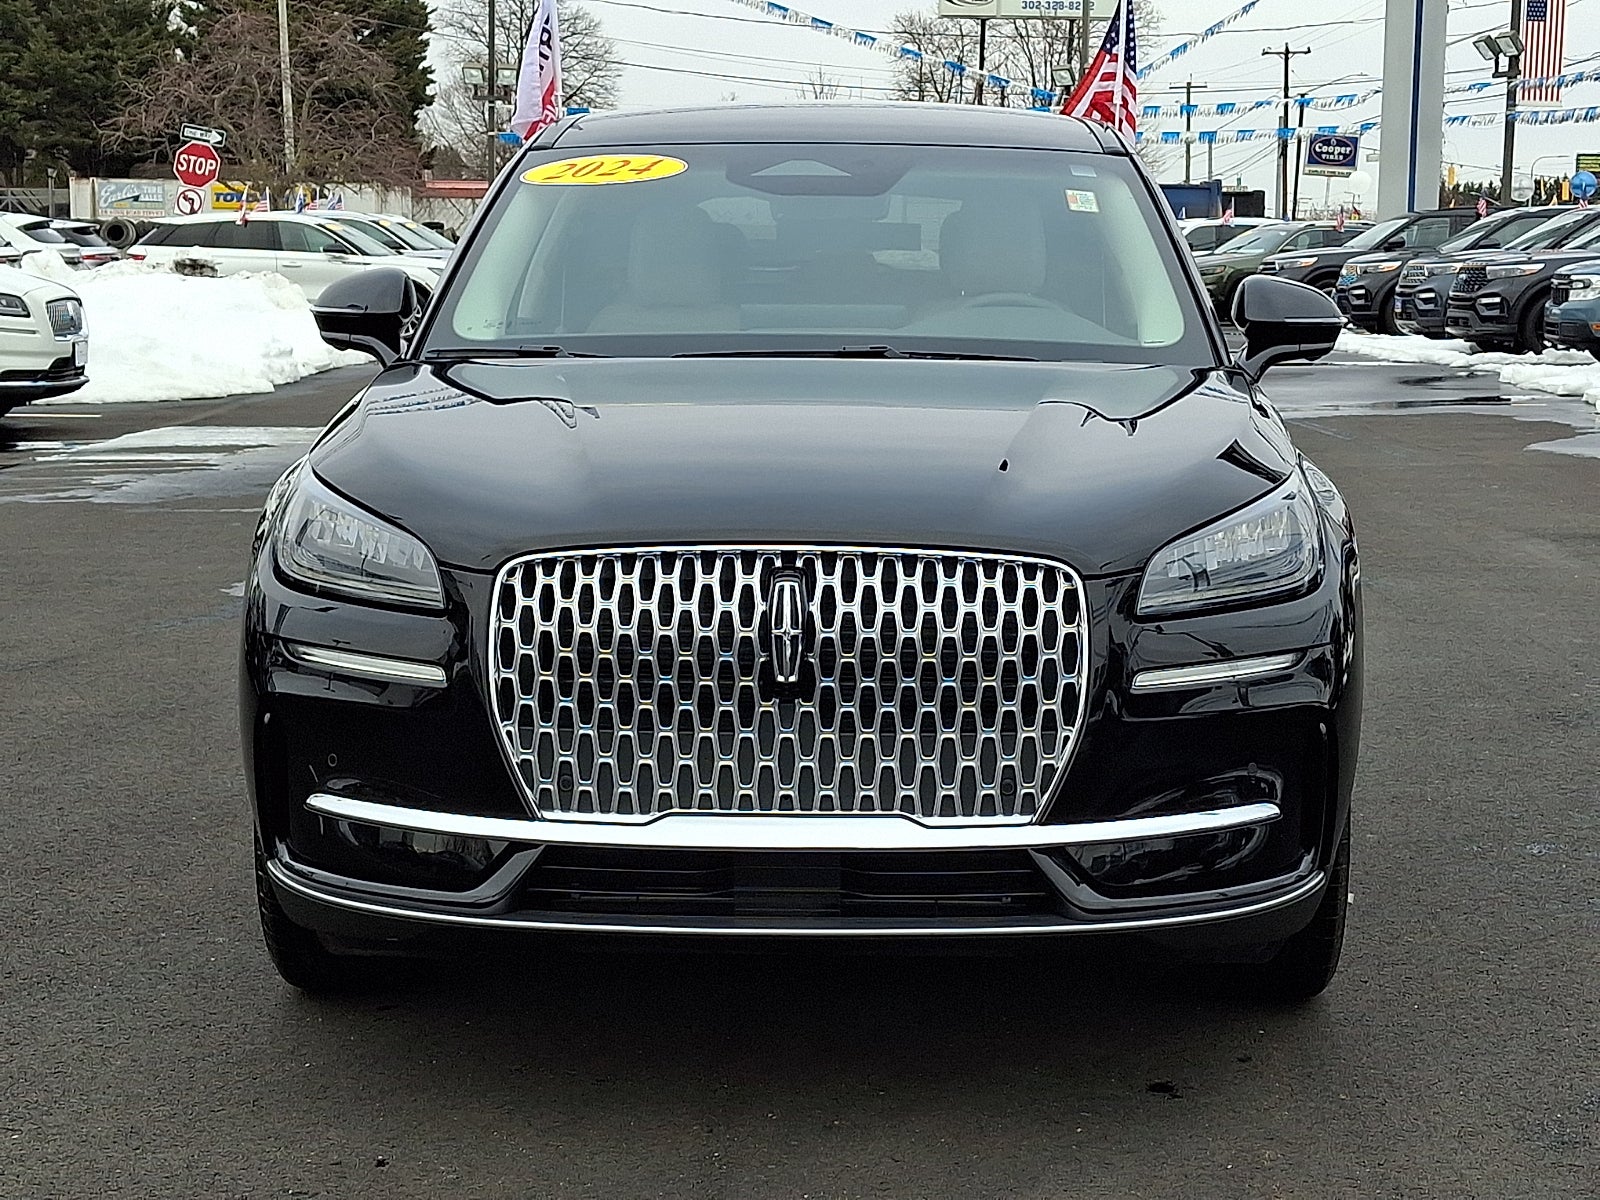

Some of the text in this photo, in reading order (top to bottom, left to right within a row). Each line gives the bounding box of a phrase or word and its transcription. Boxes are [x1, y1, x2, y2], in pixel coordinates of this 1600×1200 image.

[1021, 0, 1095, 11] 302-328-822
[1315, 143, 1351, 155] Cooper
[178, 154, 216, 176] STOP
[541, 159, 665, 181] 2024
